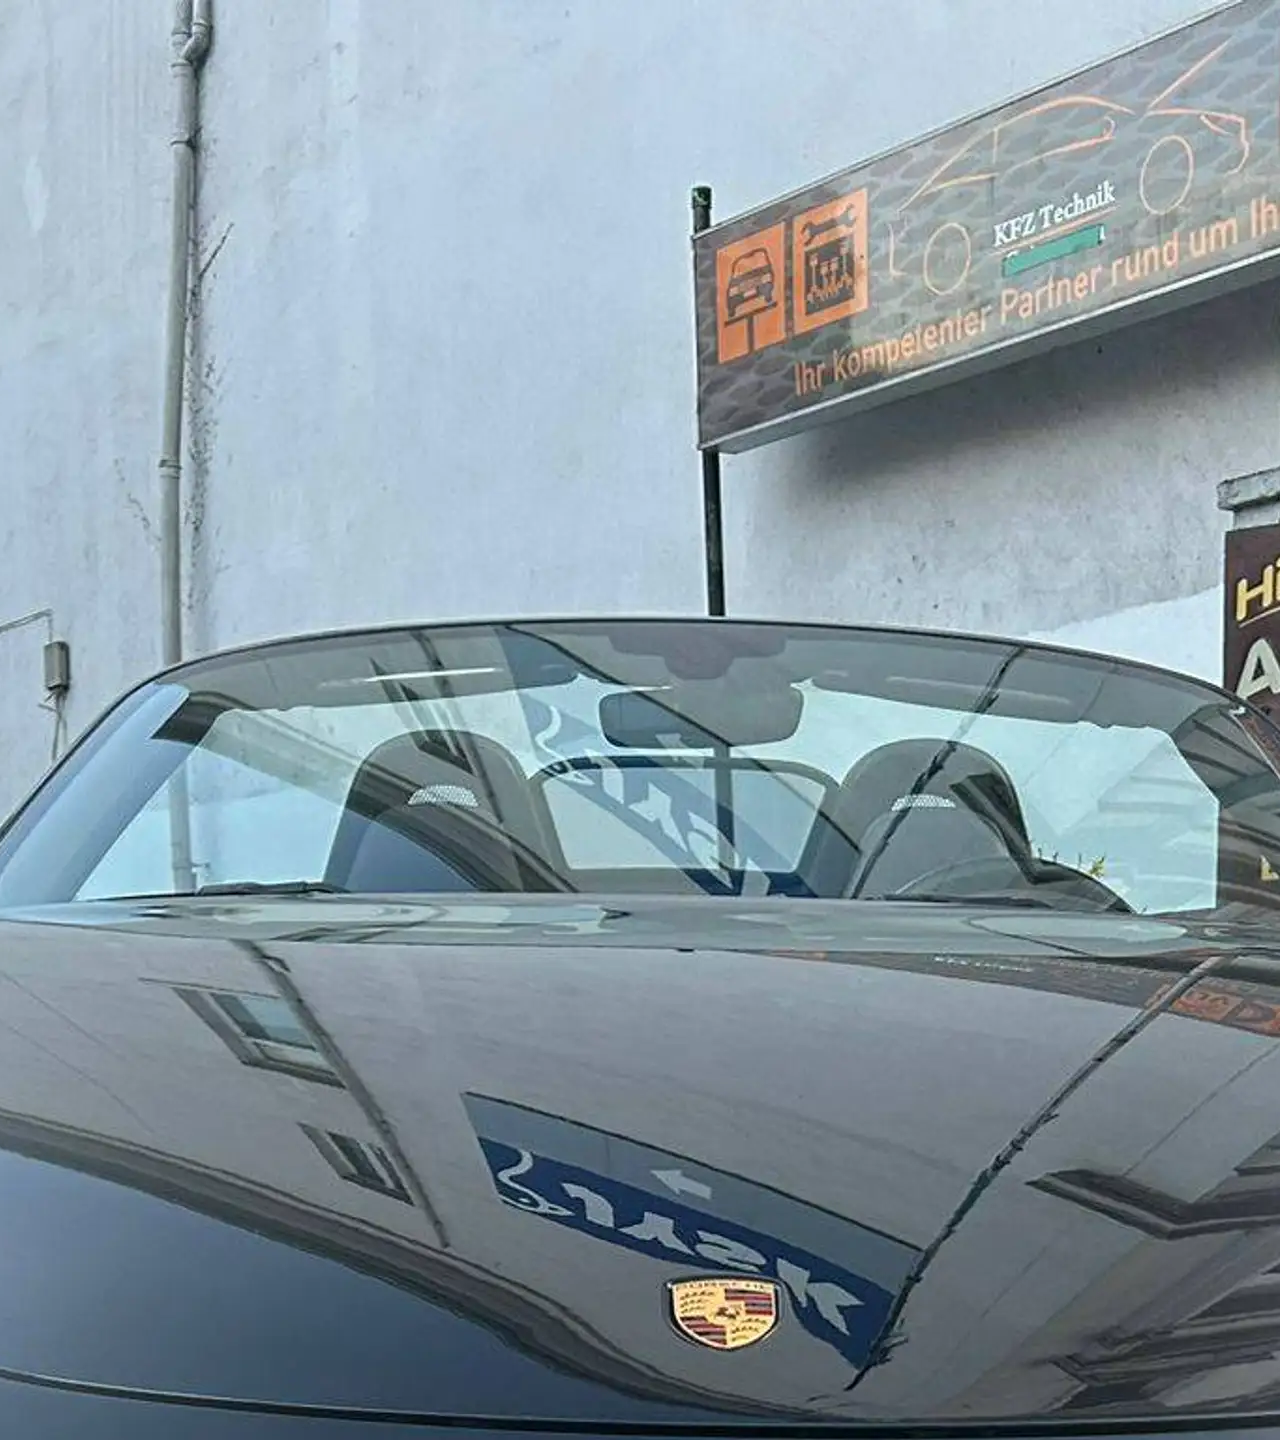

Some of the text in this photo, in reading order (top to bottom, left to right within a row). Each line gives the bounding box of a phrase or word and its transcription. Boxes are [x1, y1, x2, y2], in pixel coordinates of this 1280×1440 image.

[993, 212, 1037, 248] KFZ
[1039, 180, 1116, 228] Technik
[794, 359, 826, 397] Ihr
[831, 305, 991, 379] kompetenter
[1001, 264, 1102, 324] Partner
[1110, 237, 1180, 287] rund
[1190, 217, 1239, 255] um
